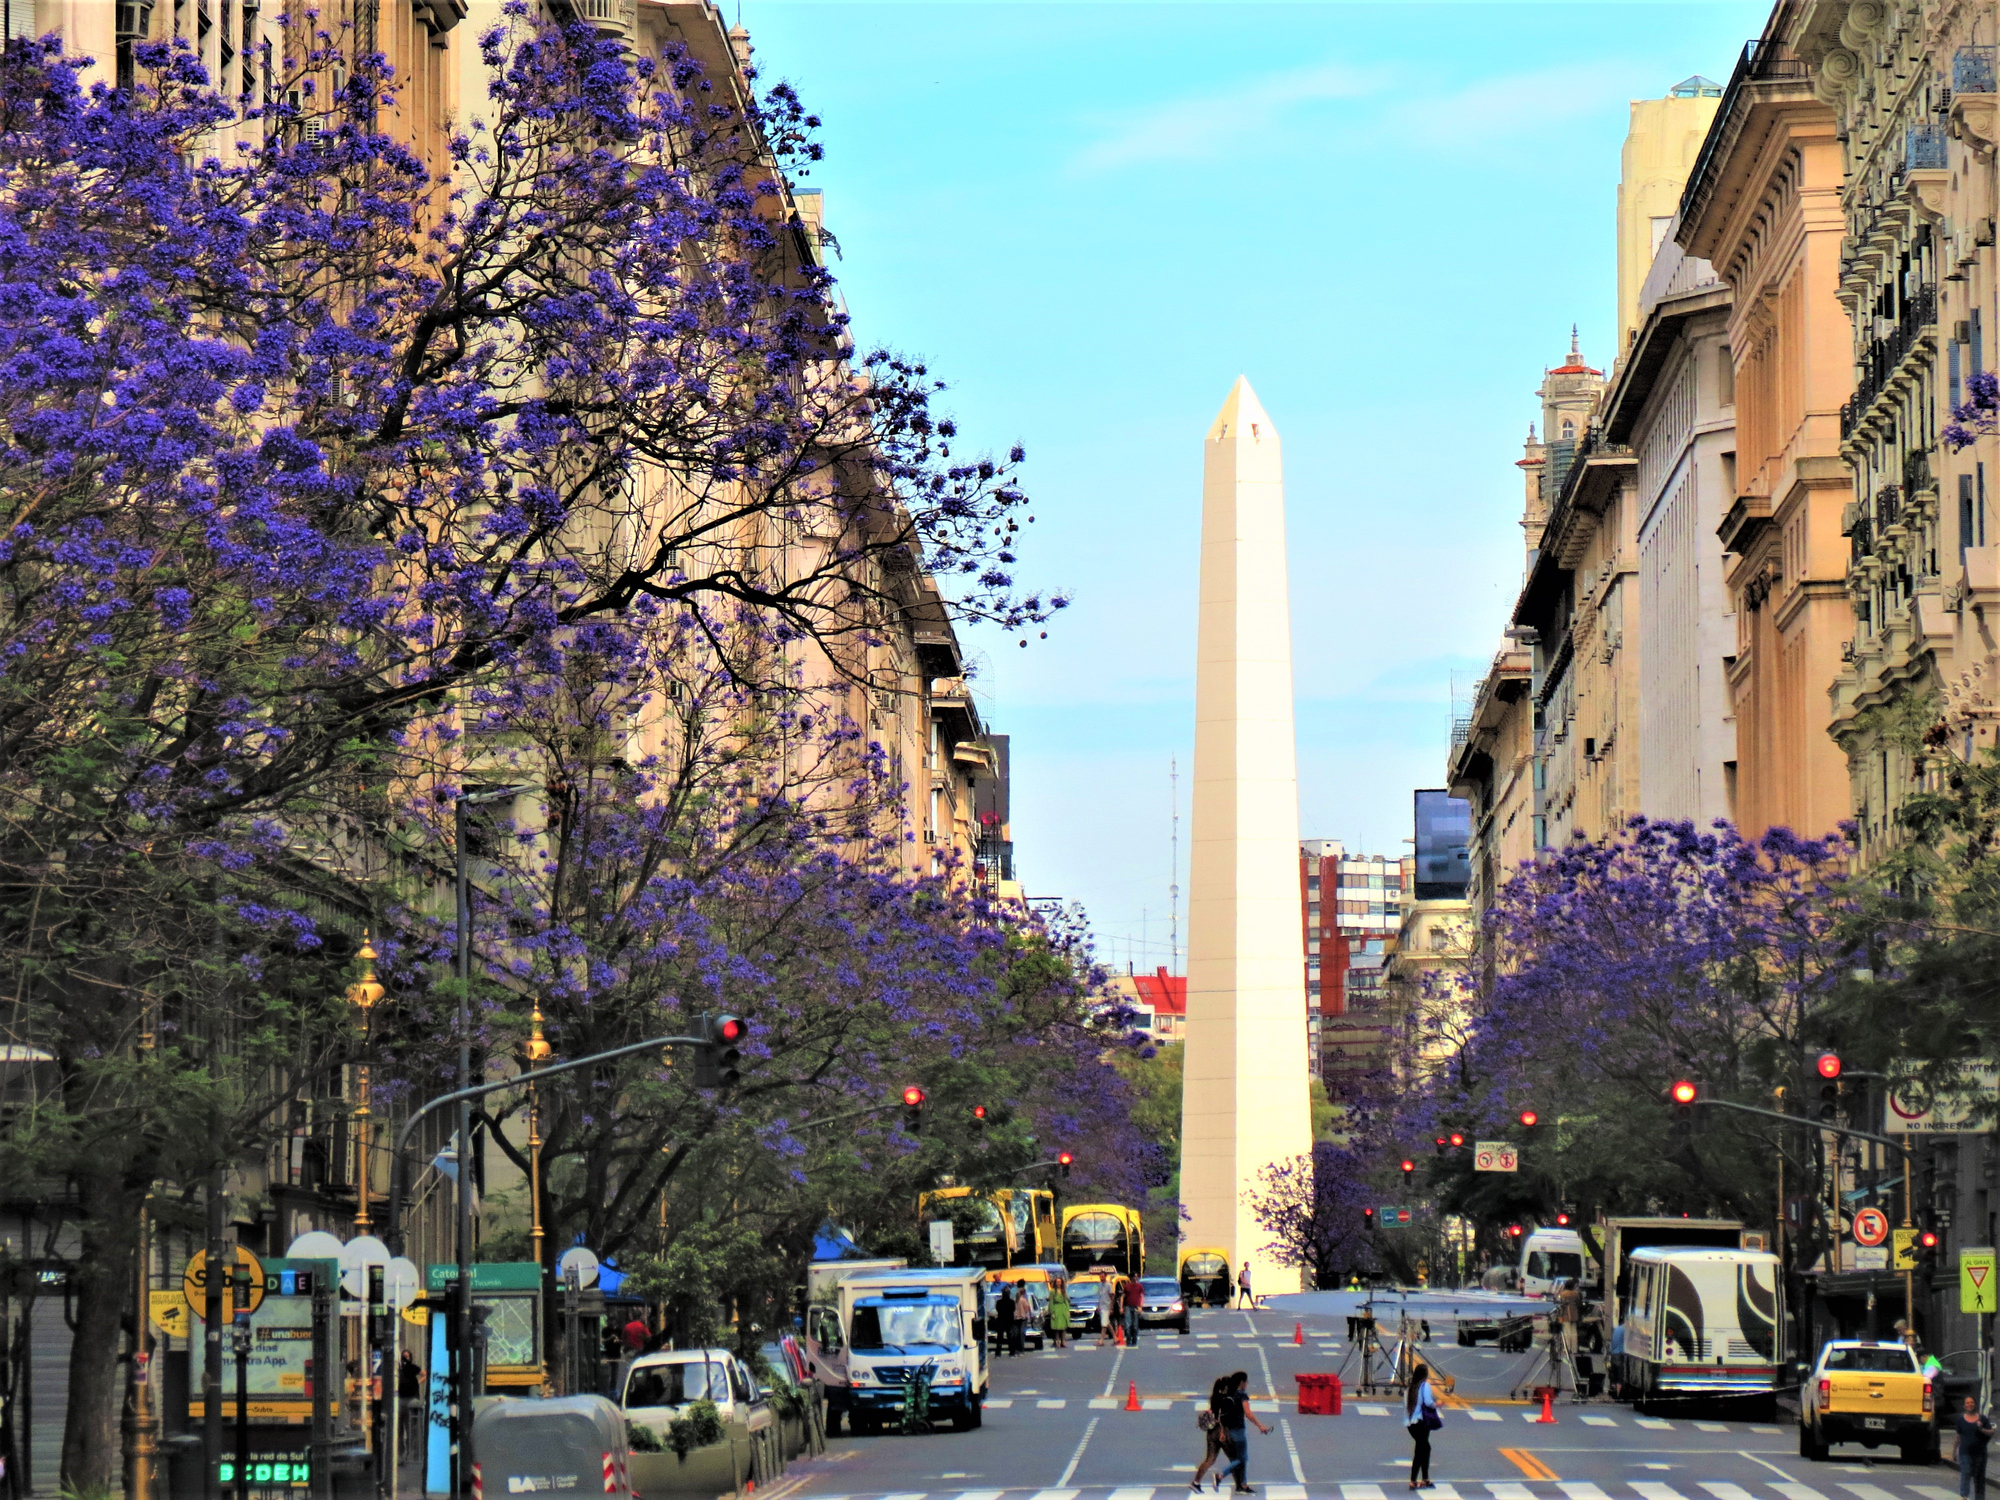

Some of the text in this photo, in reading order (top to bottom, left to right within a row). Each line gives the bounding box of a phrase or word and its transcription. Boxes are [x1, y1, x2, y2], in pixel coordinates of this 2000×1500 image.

[1906, 1122, 1921, 1130] NO
[267, 1277, 306, 1290] D A E
[252, 1406, 274, 1414] Subte
[260, 1452, 275, 1460] red
[276, 1452, 288, 1460] de
